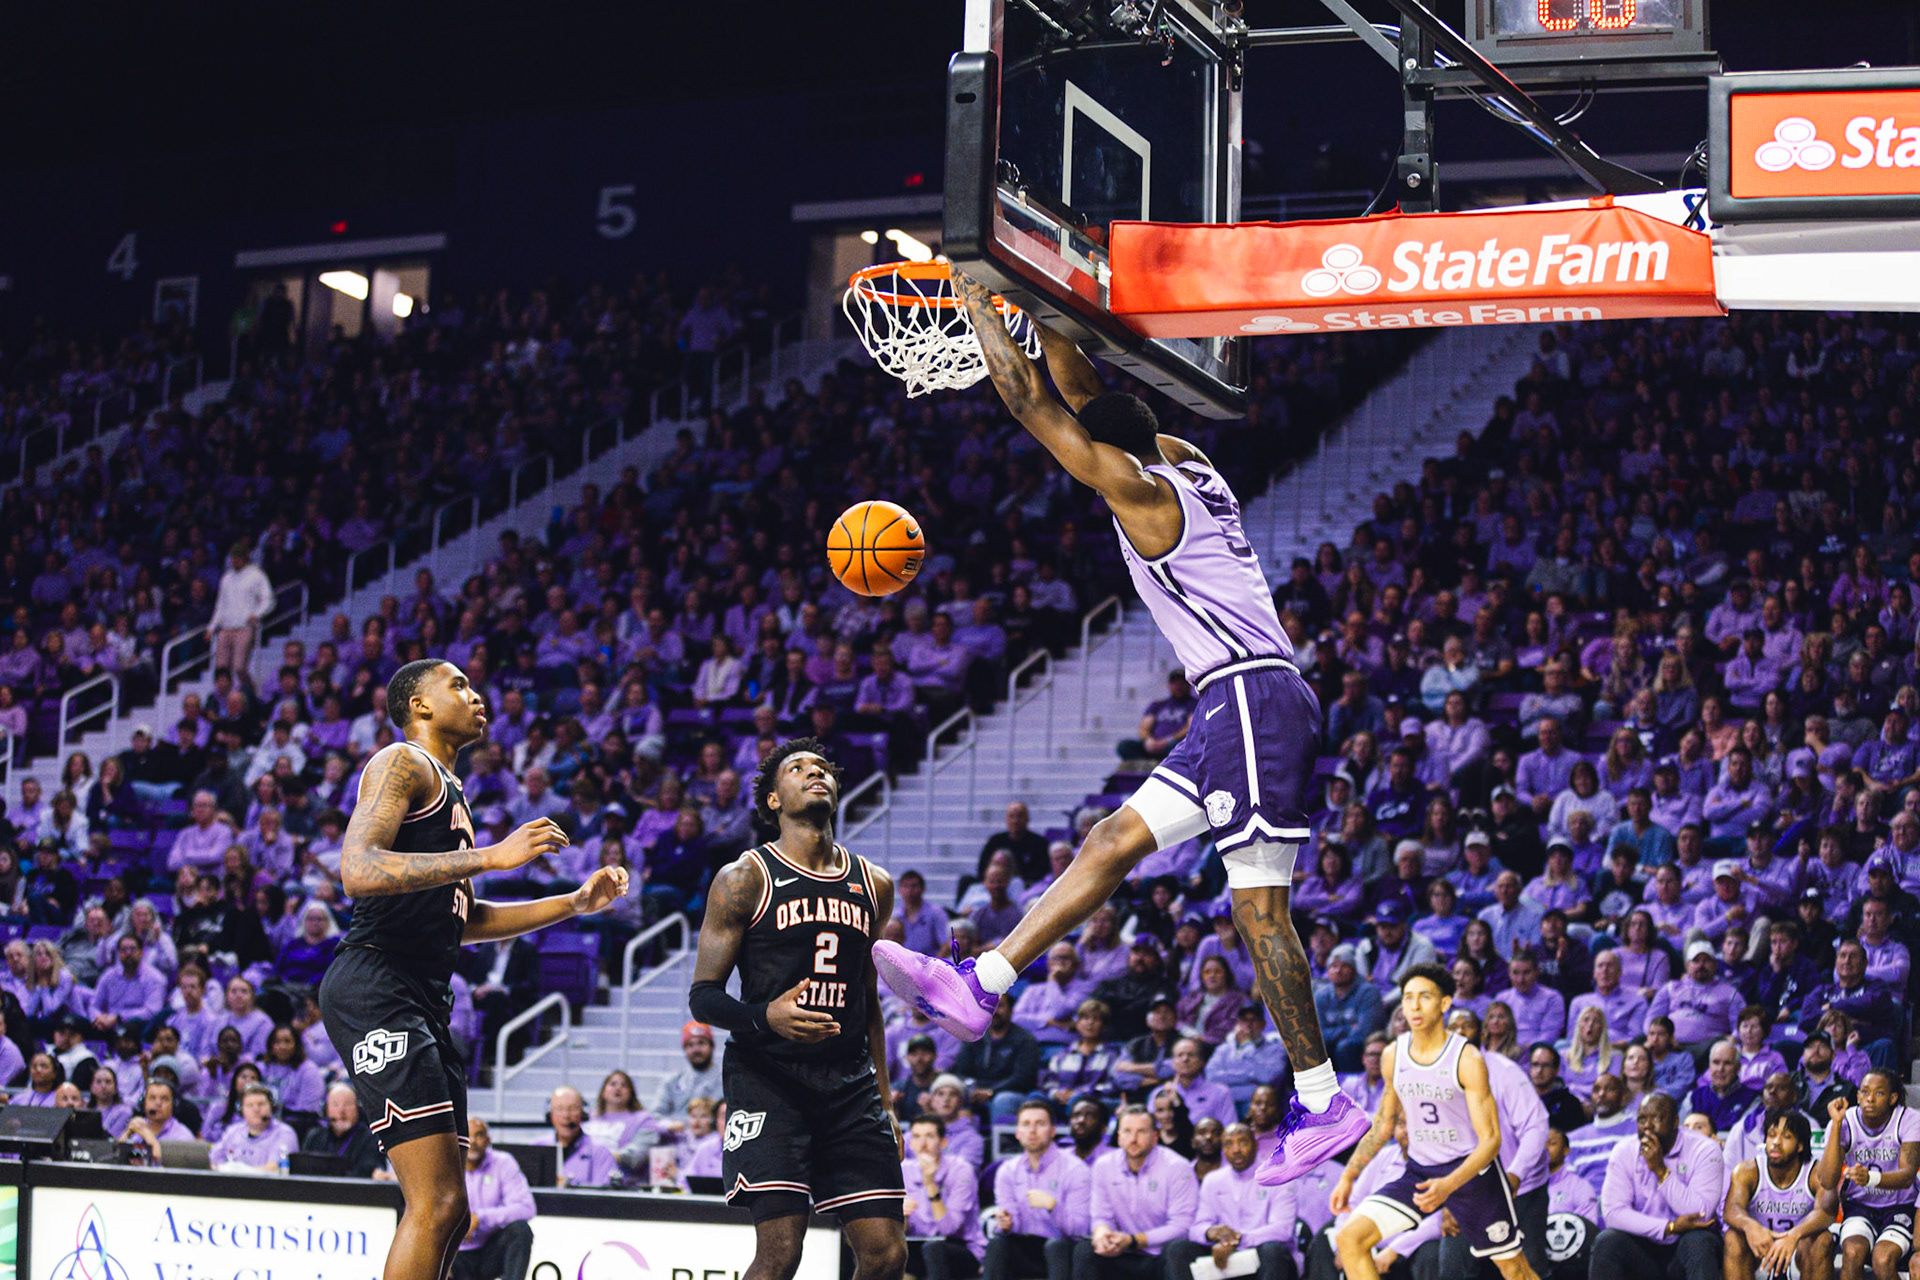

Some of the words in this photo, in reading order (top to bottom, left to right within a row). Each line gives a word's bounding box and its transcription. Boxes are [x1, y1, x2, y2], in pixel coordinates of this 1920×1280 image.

[1841, 116, 1920, 169] Sta
[598, 186, 637, 239] 5
[107, 233, 137, 281] 4
[776, 896, 870, 938] OKLAHOMA
[814, 931, 839, 974] 2
[797, 981, 847, 1008] STATE
[353, 1028, 409, 1075] OSU
[1399, 1082, 1455, 1101] KANSAS
[1420, 1102, 1440, 1125] 3
[1414, 1129, 1458, 1143] STATE
[1855, 1147, 1899, 1162] KANSAS
[1756, 1200, 1808, 1215] KANSAS
[153, 1206, 367, 1256] Ascension
